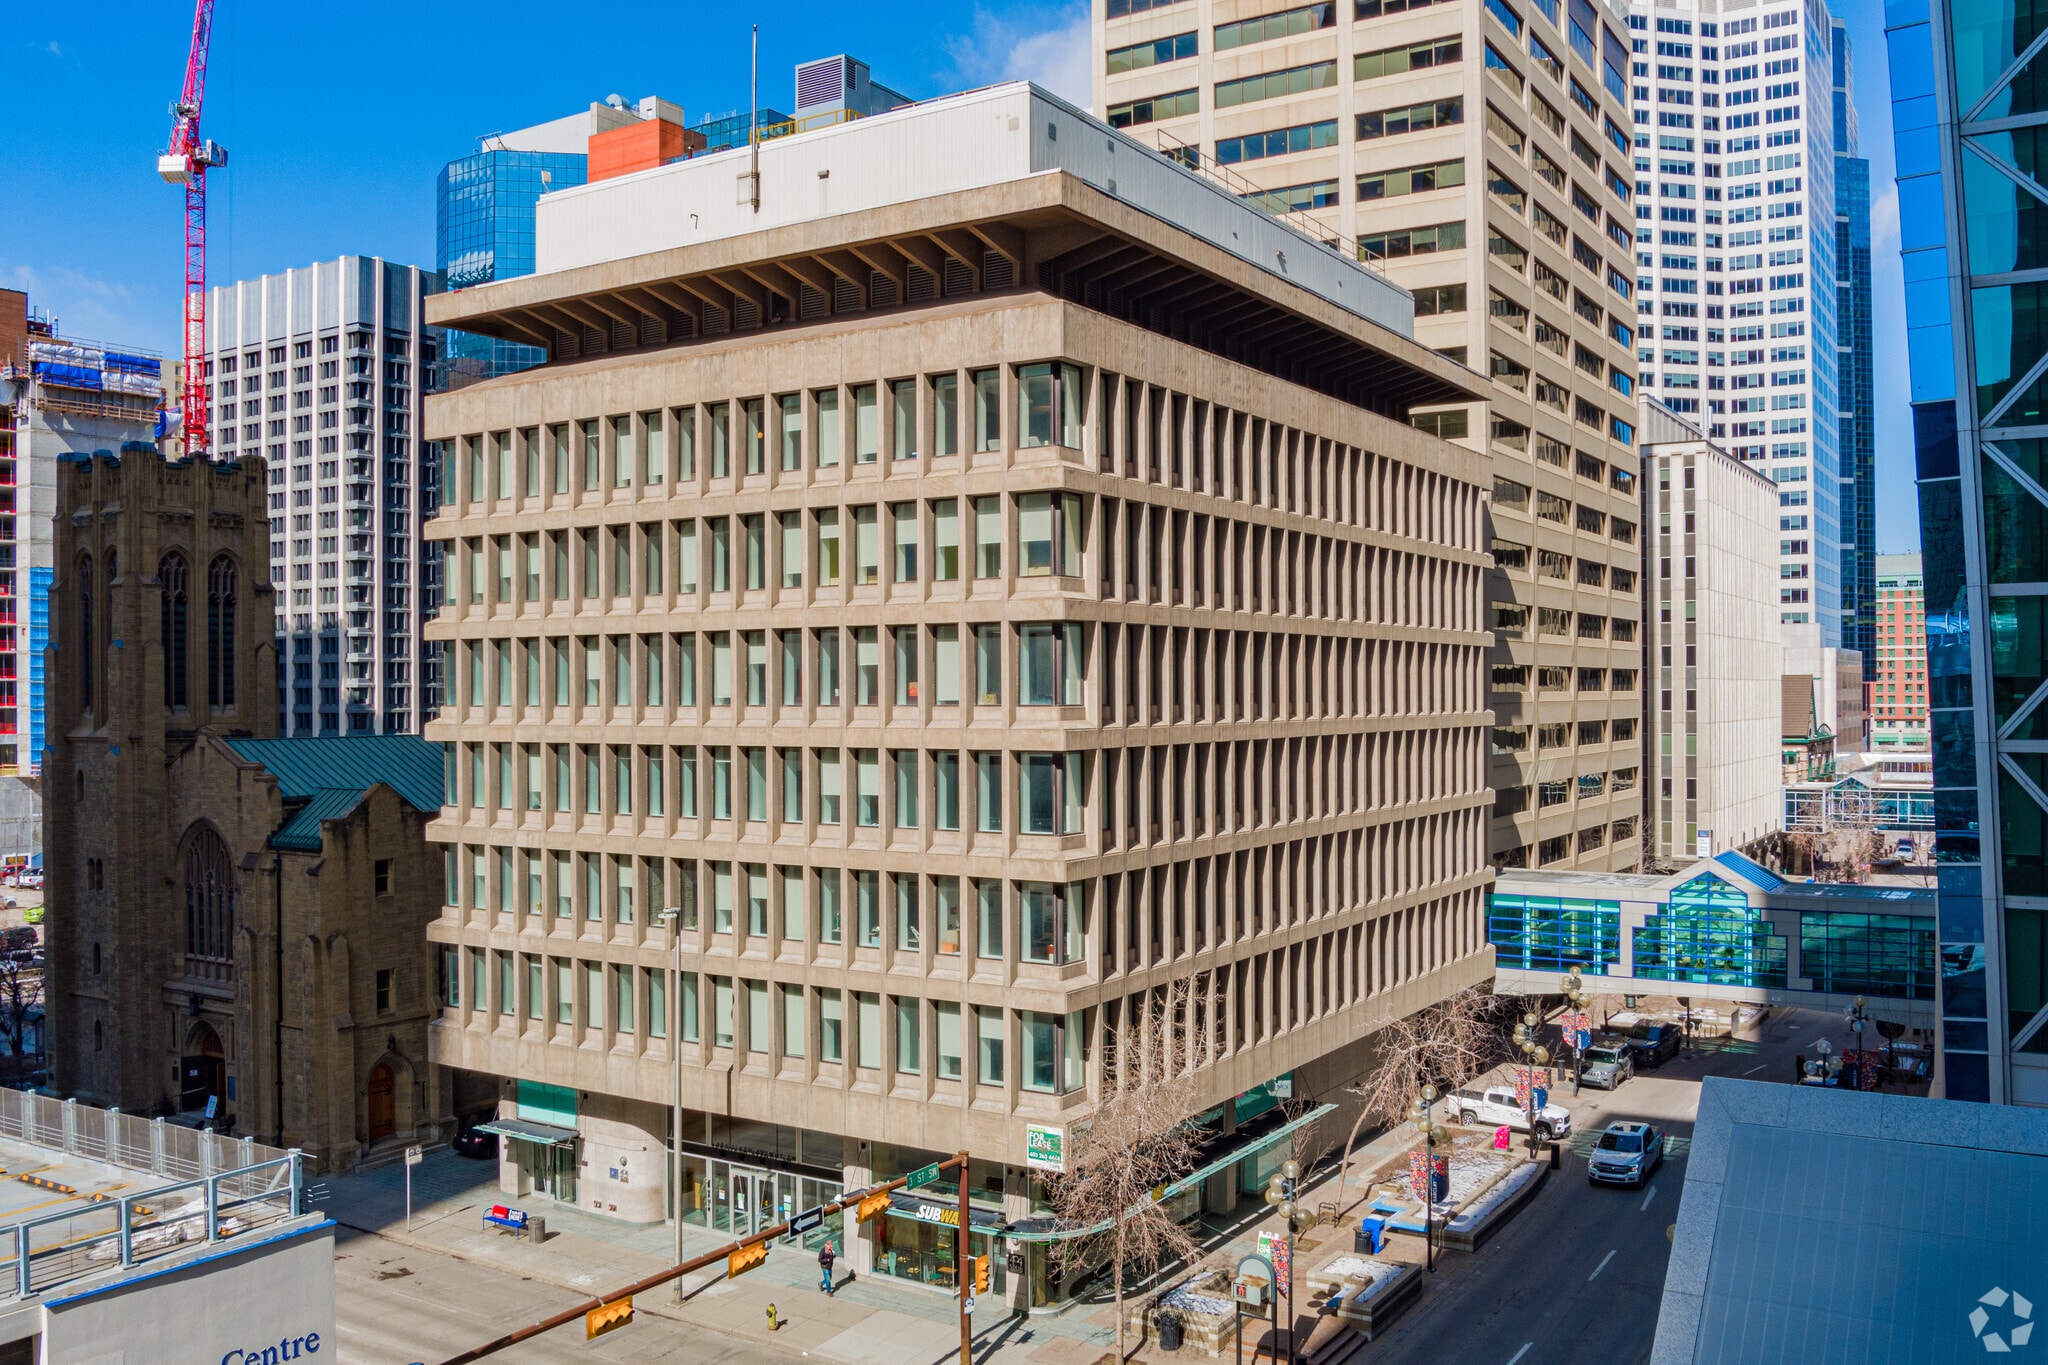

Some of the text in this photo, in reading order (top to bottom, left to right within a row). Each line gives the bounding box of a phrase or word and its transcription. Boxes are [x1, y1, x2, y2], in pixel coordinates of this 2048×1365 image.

[1029, 1131, 1045, 1141] FOR
[1029, 1138, 1052, 1150] LEASE
[909, 1167, 937, 1187] 3 ST SW
[916, 1204, 960, 1226] SUBWA
[220, 1331, 321, 1365] Centre
